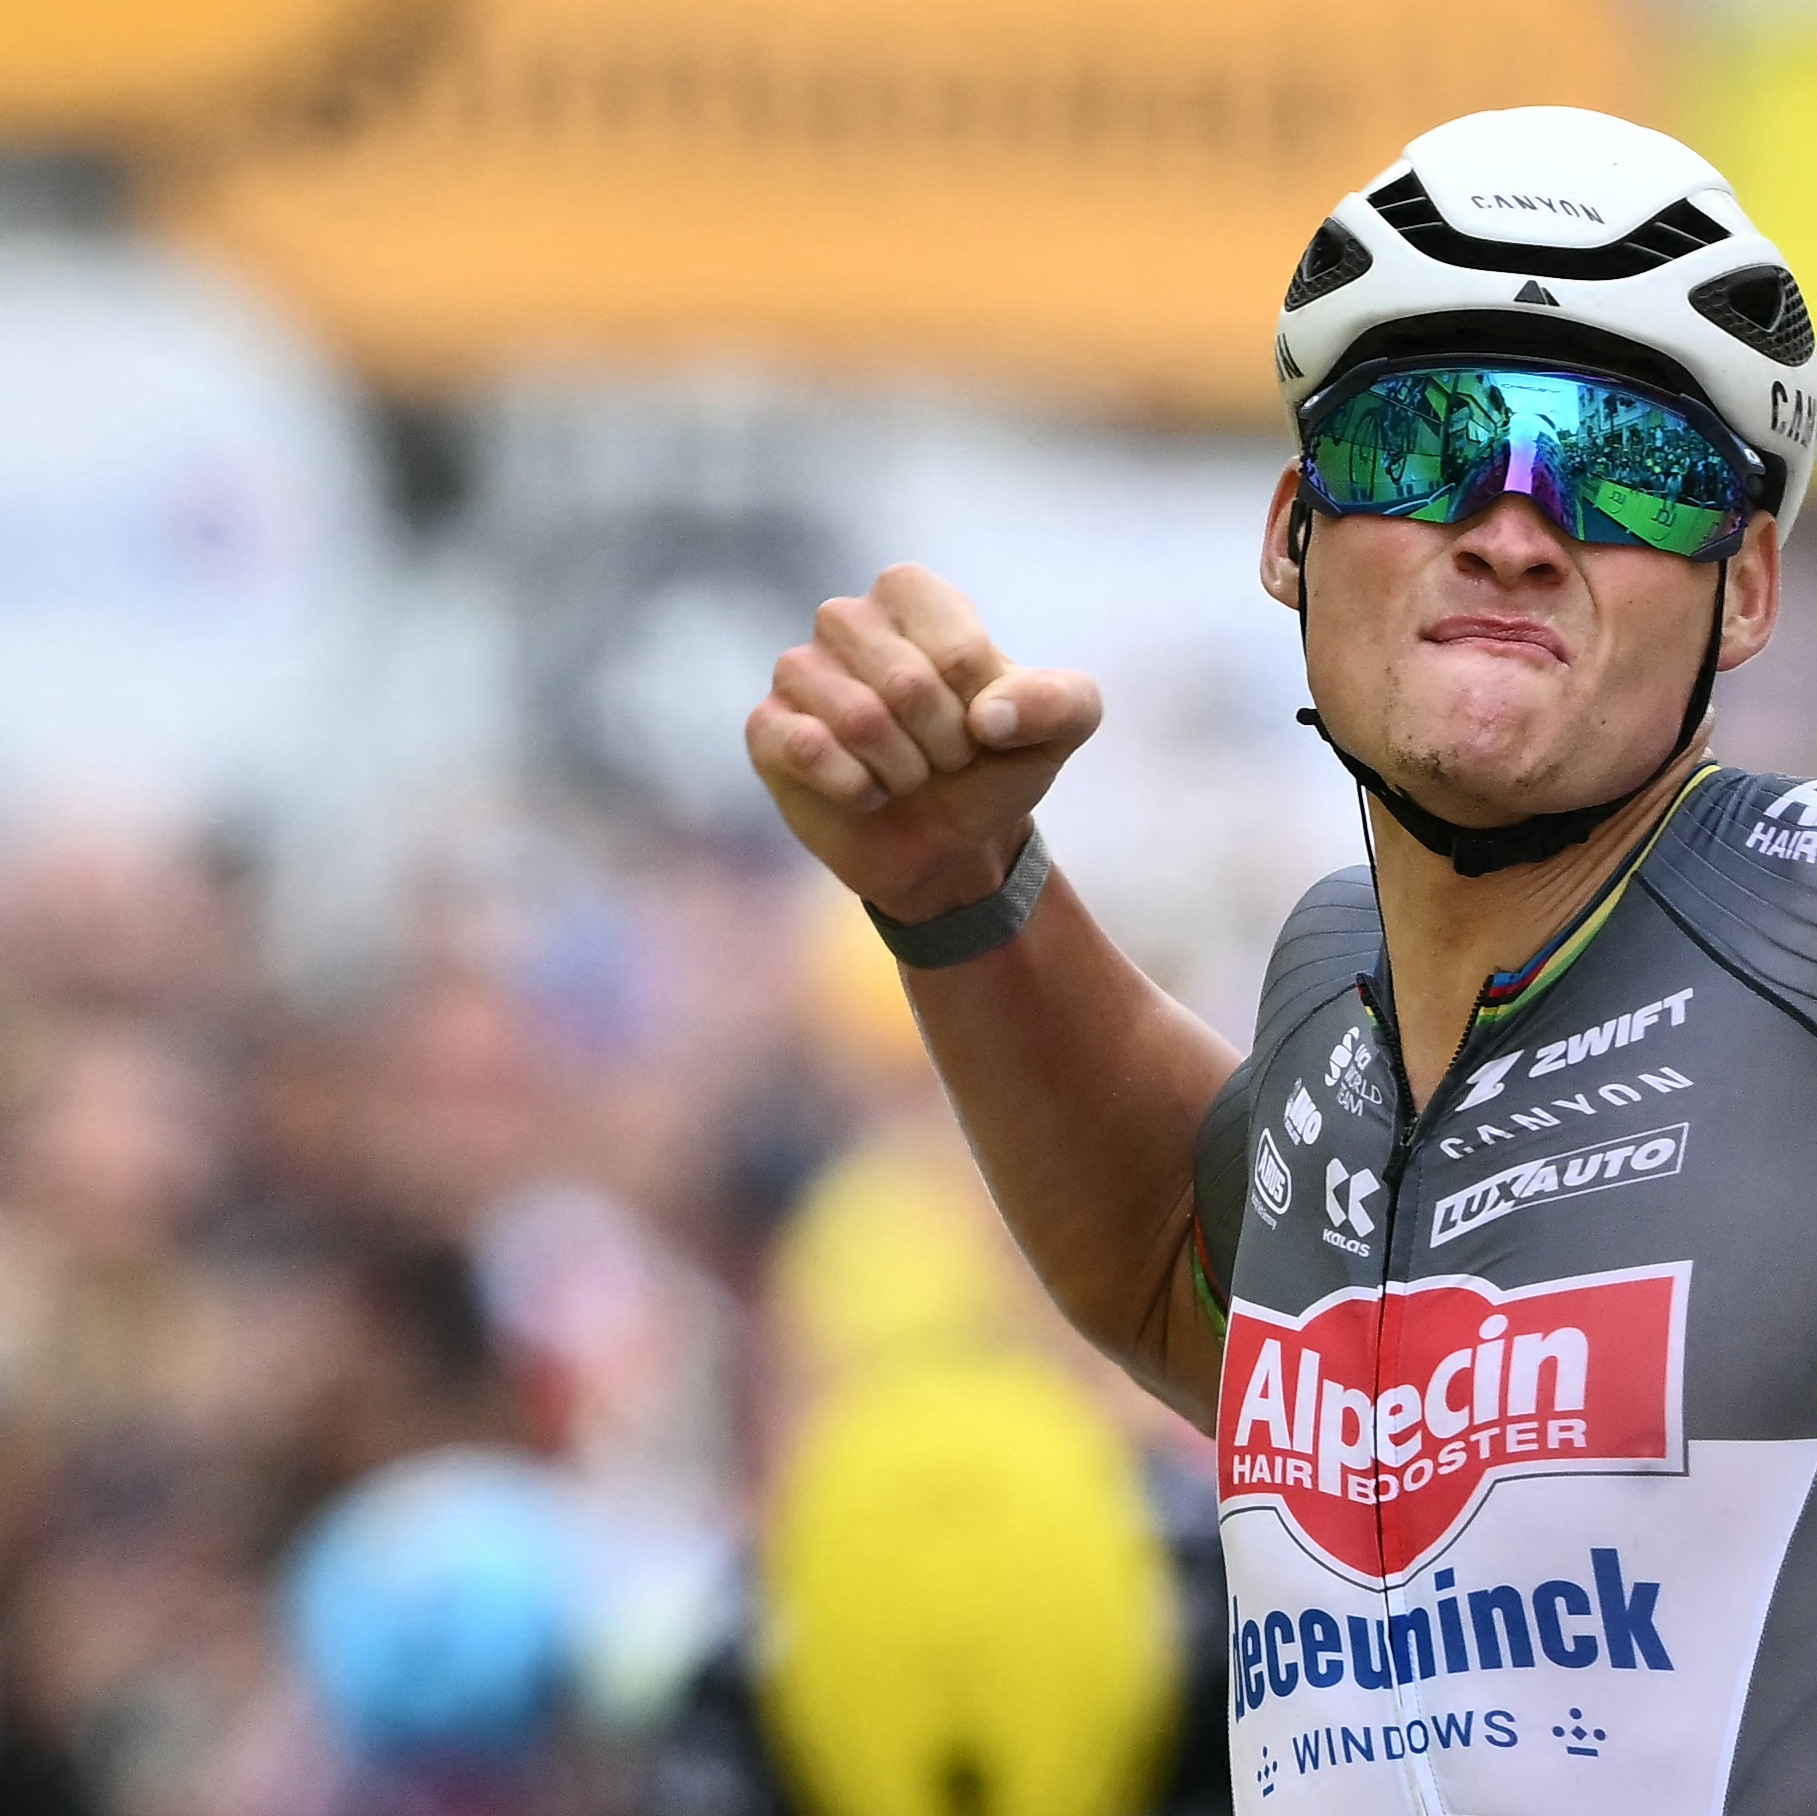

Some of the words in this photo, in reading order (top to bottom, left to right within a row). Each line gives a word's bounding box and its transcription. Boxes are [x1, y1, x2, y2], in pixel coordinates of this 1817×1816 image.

[1471, 194, 1605, 226] CANYON
[1528, 987, 1694, 1079] ZWIFT
[1439, 1066, 1695, 1161] CANYON
[1234, 1314, 1589, 1497] Alpecin
[1232, 1453, 1313, 1490] HAIR
[1347, 1418, 1588, 1506] BOOSTER
[1291, 1708, 1520, 1776] WINDOWS
